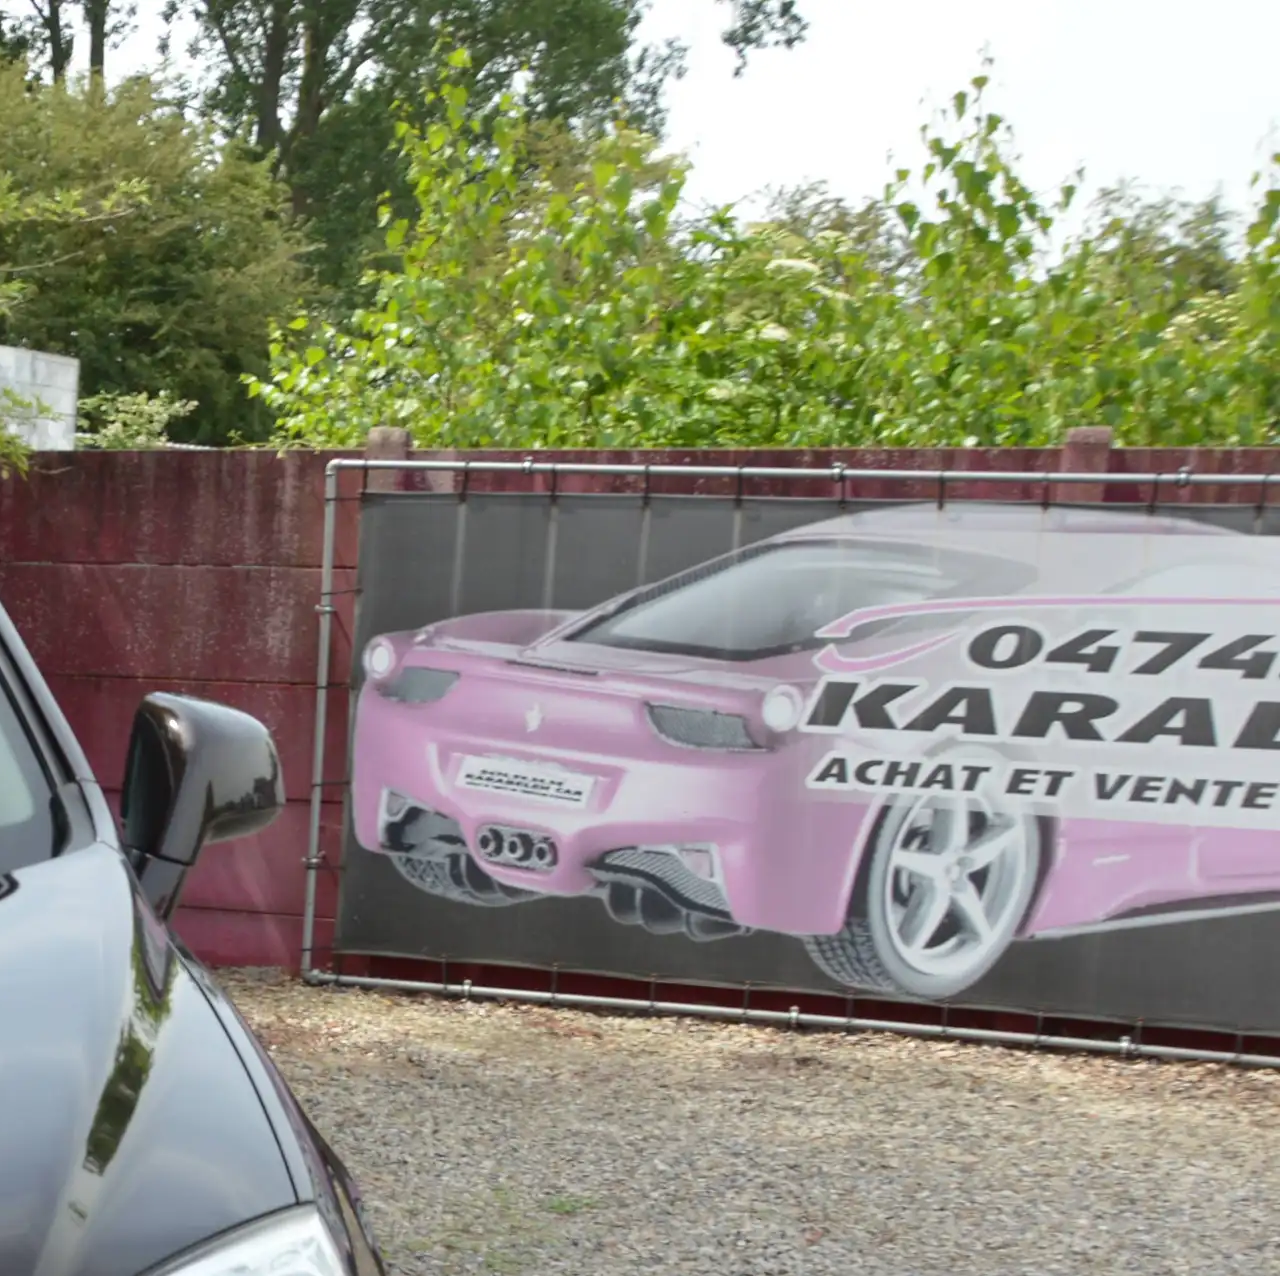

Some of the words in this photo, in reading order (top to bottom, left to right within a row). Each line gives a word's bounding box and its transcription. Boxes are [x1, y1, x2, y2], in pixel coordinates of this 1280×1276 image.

[813, 757, 992, 793] ACHAT
[1004, 768, 1075, 798] ET
[1094, 772, 1278, 810] VENTE
